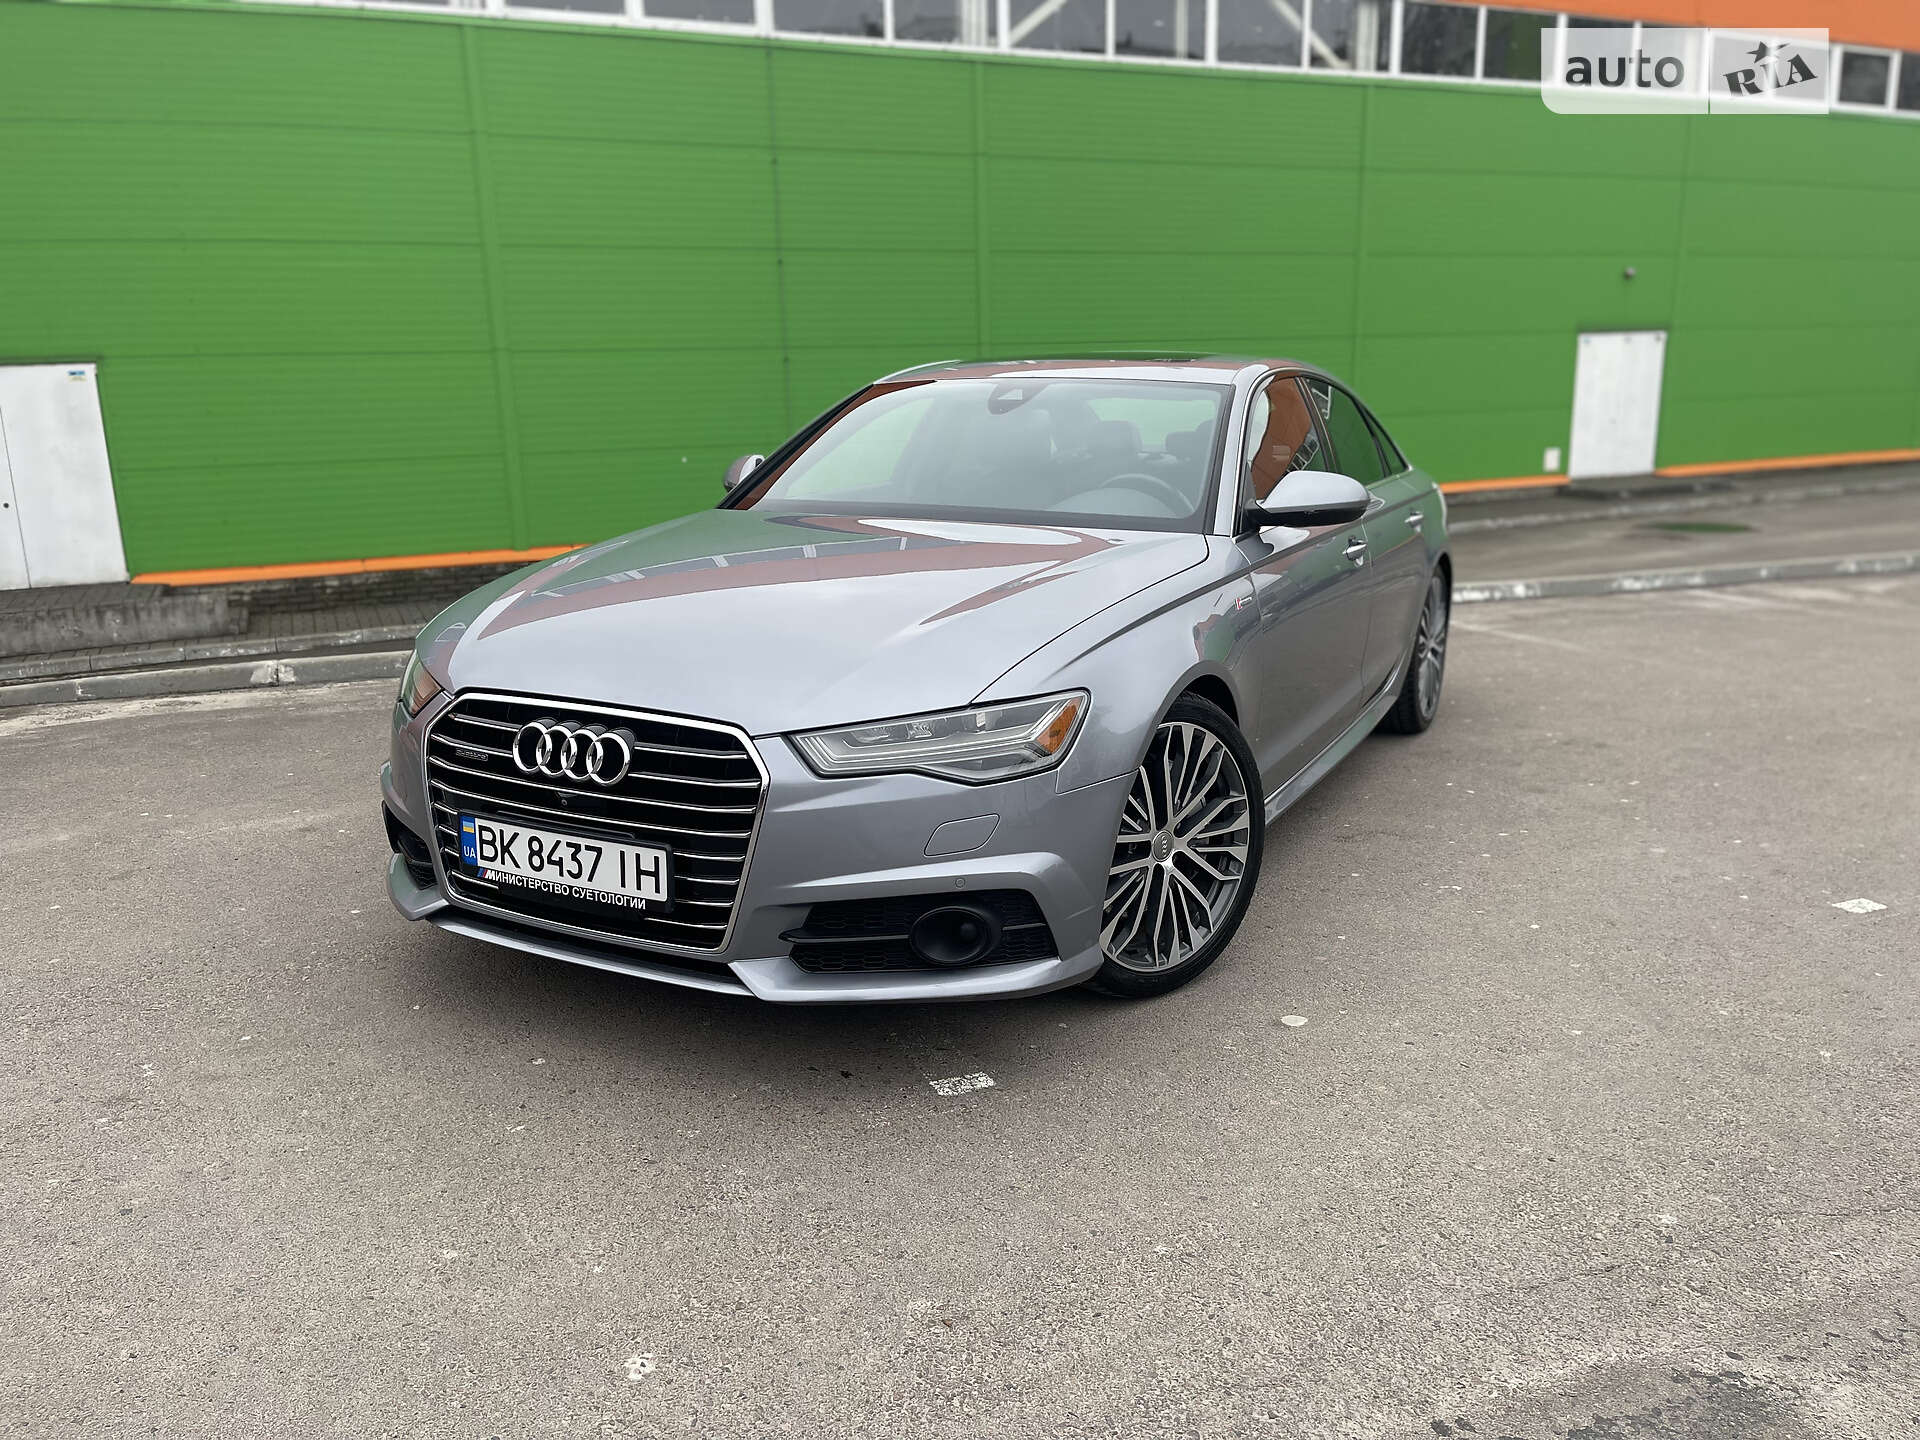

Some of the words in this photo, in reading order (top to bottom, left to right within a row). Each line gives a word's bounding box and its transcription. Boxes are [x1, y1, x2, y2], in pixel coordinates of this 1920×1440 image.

[463, 845, 476, 859] UA
[478, 825, 520, 868] BK
[527, 835, 603, 882] 8437
[619, 850, 661, 894] IH
[571, 886, 646, 910] СУЕТОЛОГИИ
